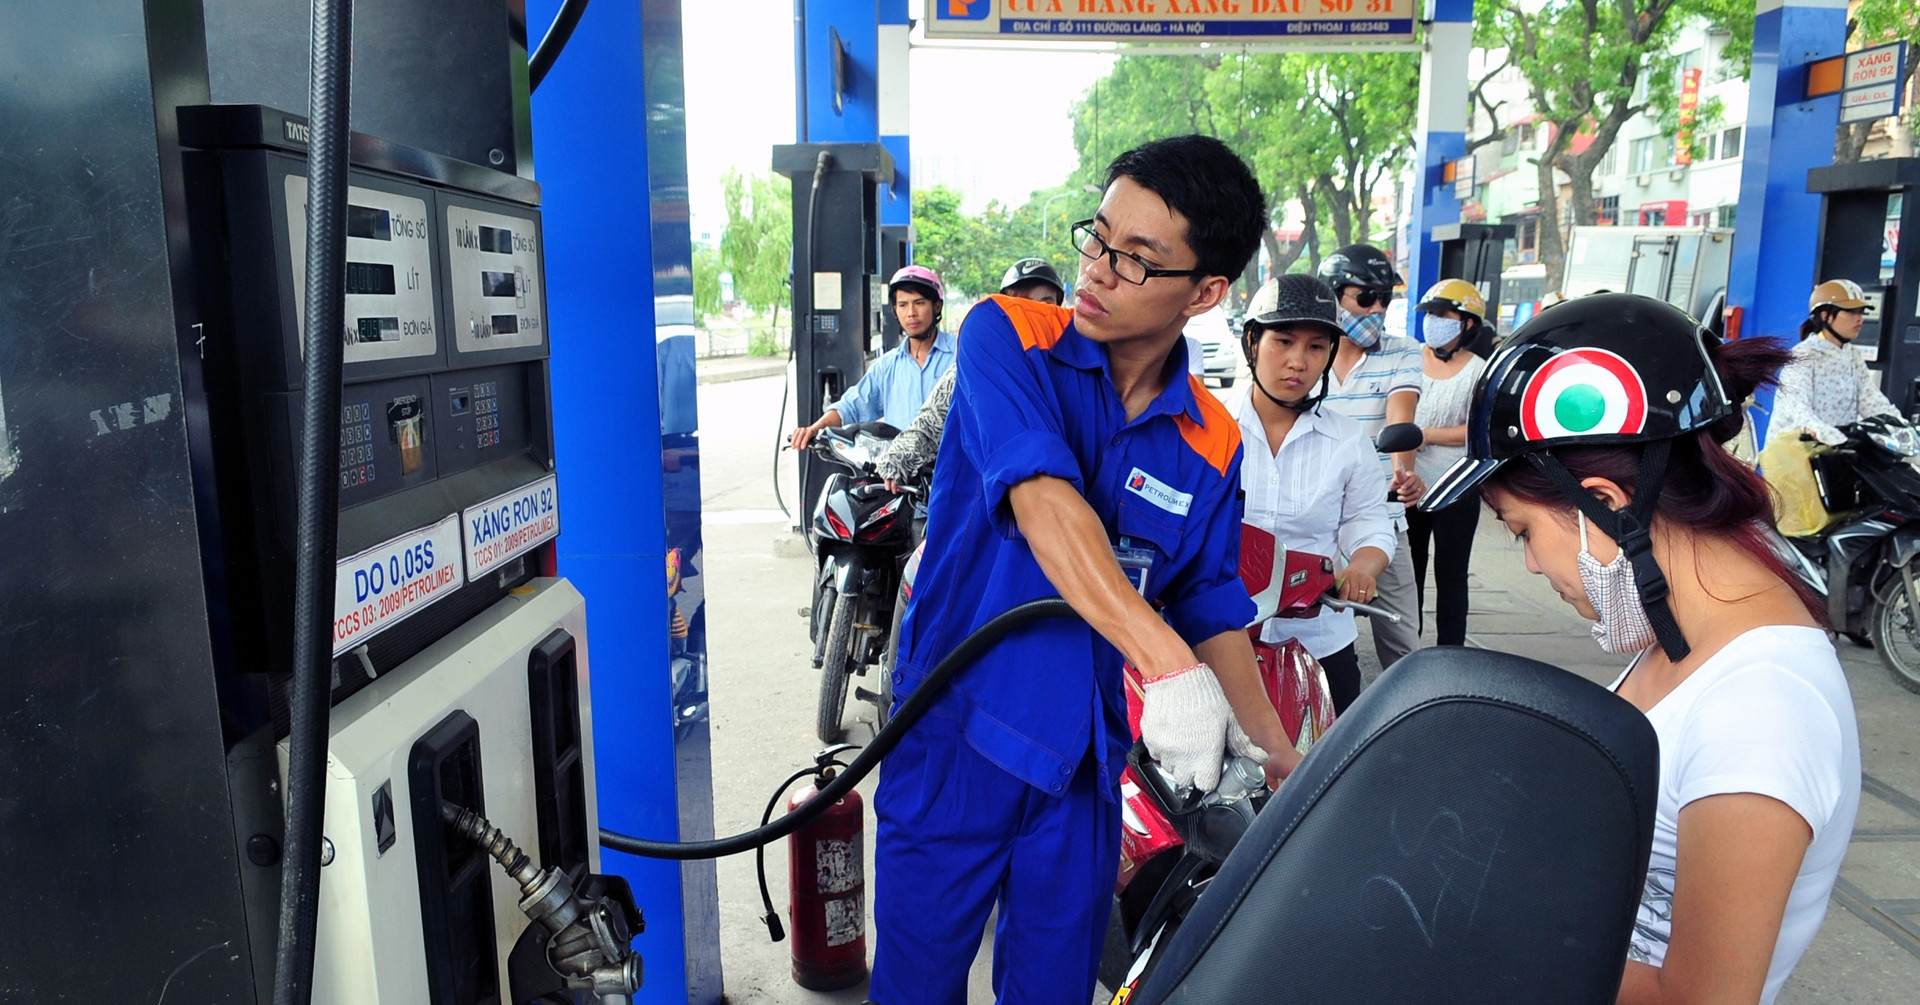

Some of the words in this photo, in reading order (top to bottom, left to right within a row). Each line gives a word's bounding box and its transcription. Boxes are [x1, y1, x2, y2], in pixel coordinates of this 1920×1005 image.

[1076, 22, 1092, 32] 111
[1853, 69, 1877, 82] RON
[1880, 65, 1894, 76] 92
[407, 267, 419, 290] LÍT
[192, 323, 206, 359] 7
[1144, 483, 1189, 509] PETROLIMEX
[472, 507, 510, 547] XĂNG
[513, 493, 539, 527] RON
[541, 487, 553, 514] 92
[474, 545, 493, 569] TCCS
[354, 562, 384, 603] DO
[390, 540, 434, 587] 0,05S
